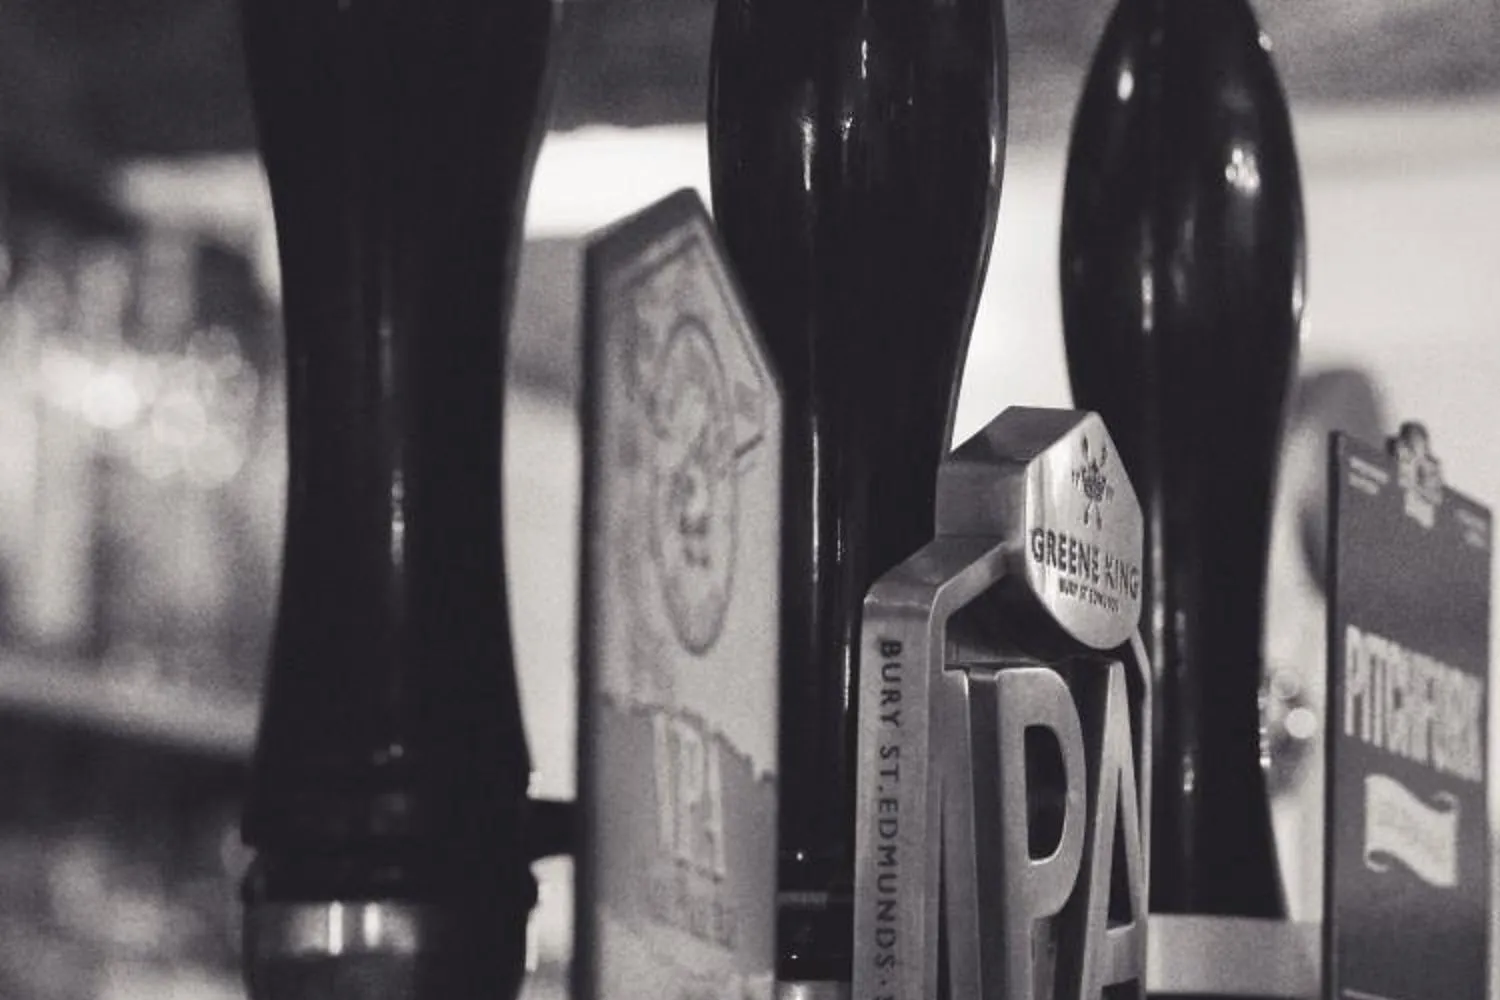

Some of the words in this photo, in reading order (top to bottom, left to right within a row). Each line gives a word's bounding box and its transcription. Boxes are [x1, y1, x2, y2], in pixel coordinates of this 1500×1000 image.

[1031, 527, 1099, 585] GREENE
[1104, 553, 1140, 601] KING
[879, 639, 903, 729] BURY
